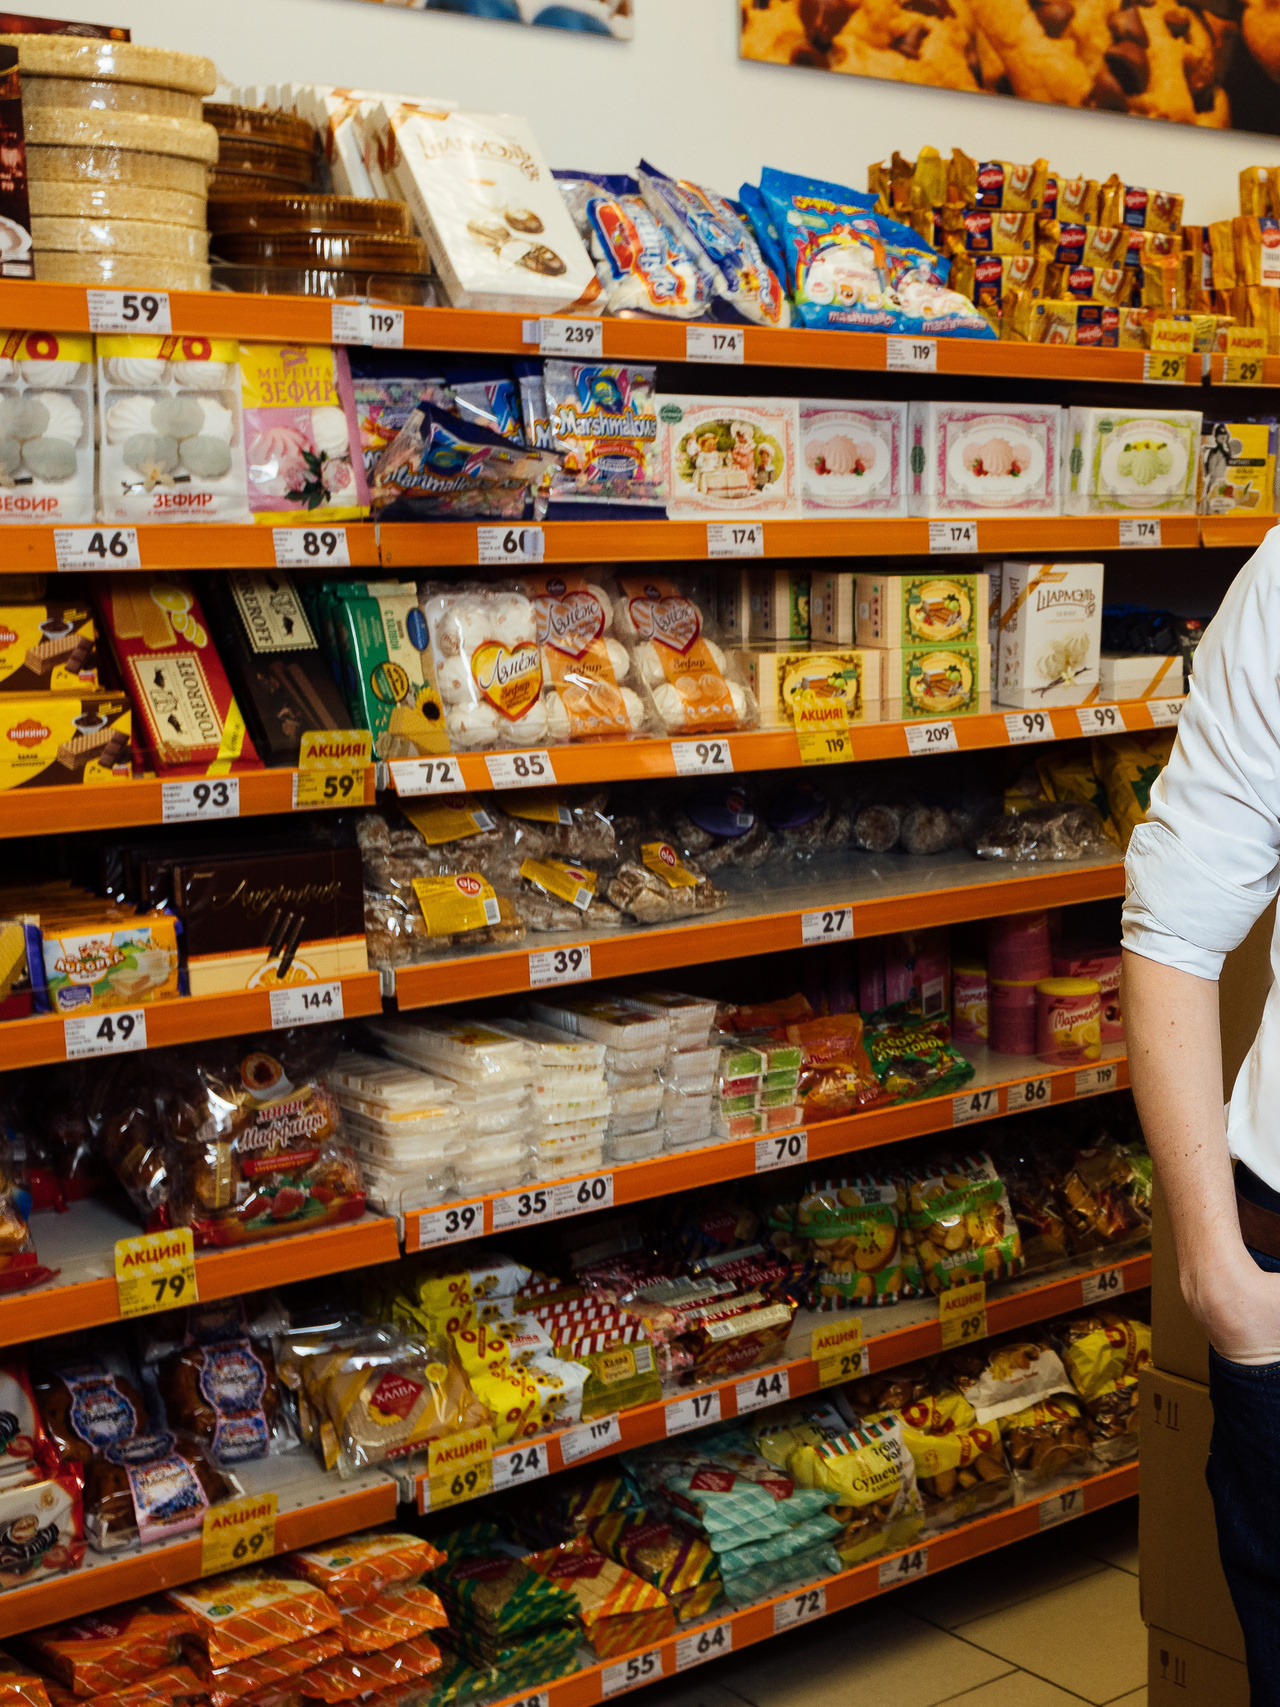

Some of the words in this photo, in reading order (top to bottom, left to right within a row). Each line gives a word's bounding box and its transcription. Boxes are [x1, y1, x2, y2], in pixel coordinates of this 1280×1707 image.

[122, 295, 159, 322] 59
[369, 314, 394, 332] 119
[565, 326, 594, 343] 239
[712, 335, 736, 350] 174
[912, 345, 930, 360] 119
[1162, 359, 1180, 377] 29
[1240, 363, 1256, 380] 29
[260, 380, 337, 404] ЗЕФИР
[0, 497, 59, 512] ЕФИР
[153, 493, 213, 508] ЗЕФИР
[732, 529, 756, 544] 174
[950, 527, 971, 541] 174
[1137, 523, 1155, 536] 174
[88, 531, 128, 558] 46
[303, 531, 337, 556] 89
[1036, 588, 1096, 612] ШАРМЭЛЬ
[800, 706, 843, 723] АКЦИЯ!
[1022, 714, 1045, 734] 99
[1095, 708, 1116, 726] 99
[10, 727, 48, 740] ЯШКИНО
[926, 726, 950, 743] 209
[306, 743, 366, 760] АКЦИЯ!
[696, 742, 724, 765] 92
[825, 738, 844, 753] 119
[418, 761, 455, 784] 72
[513, 755, 545, 777] 85
[193, 782, 230, 809] 93
[323, 775, 354, 798] 59
[822, 910, 846, 934] 27
[554, 949, 583, 974] 39
[301, 990, 333, 1010] 144
[97, 1015, 135, 1042] 49
[1097, 1067, 1112, 1083] 119
[1025, 1080, 1047, 1101] 86
[970, 1092, 992, 1112] 47
[775, 1136, 801, 1160] 70
[577, 1178, 606, 1203] 60
[518, 1190, 548, 1216] 35
[445, 1208, 476, 1234] 39
[813, 1206, 886, 1228] Сухарики
[122, 1243, 187, 1268] АКЦИЯ!
[152, 1274, 186, 1302] 79
[1097, 1274, 1118, 1291] 46
[960, 1317, 981, 1338] 29
[816, 1328, 859, 1351] АКЦИЯ!
[840, 1353, 861, 1375] 29
[376, 1383, 417, 1404] ХАЛВА
[755, 1374, 783, 1398] 44
[691, 1394, 710, 1418] 17
[590, 1421, 611, 1439] 119
[434, 1438, 488, 1465] АКЦИЯ!
[510, 1451, 540, 1475] 24
[450, 1470, 478, 1496] 69
[1058, 1490, 1075, 1512] 17
[210, 1502, 272, 1532] АКЦИЯ!
[232, 1533, 264, 1559] 69
[898, 1552, 922, 1573] 44
[794, 1590, 820, 1616] 72
[696, 1628, 724, 1653] 64
[626, 1656, 655, 1680] 55
